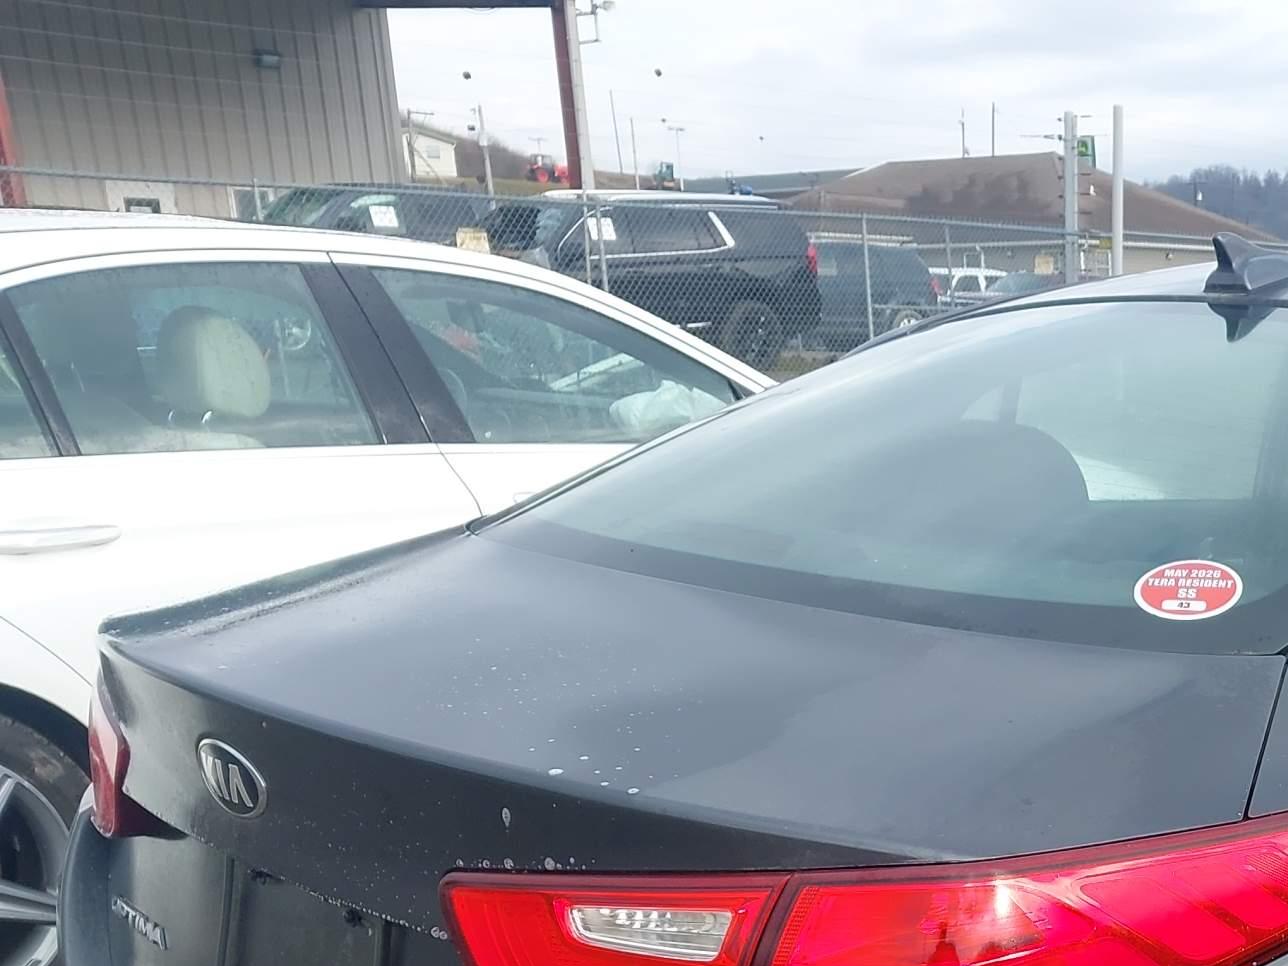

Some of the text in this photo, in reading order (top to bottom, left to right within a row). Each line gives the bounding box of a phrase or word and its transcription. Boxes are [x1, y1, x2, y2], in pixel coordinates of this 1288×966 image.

[1164, 569, 1189, 577] MAY
[1177, 578, 1234, 589] RESIDENT
[1177, 588, 1197, 598] SS
[200, 751, 254, 808] KIA
[111, 897, 167, 948] OPTIMA
